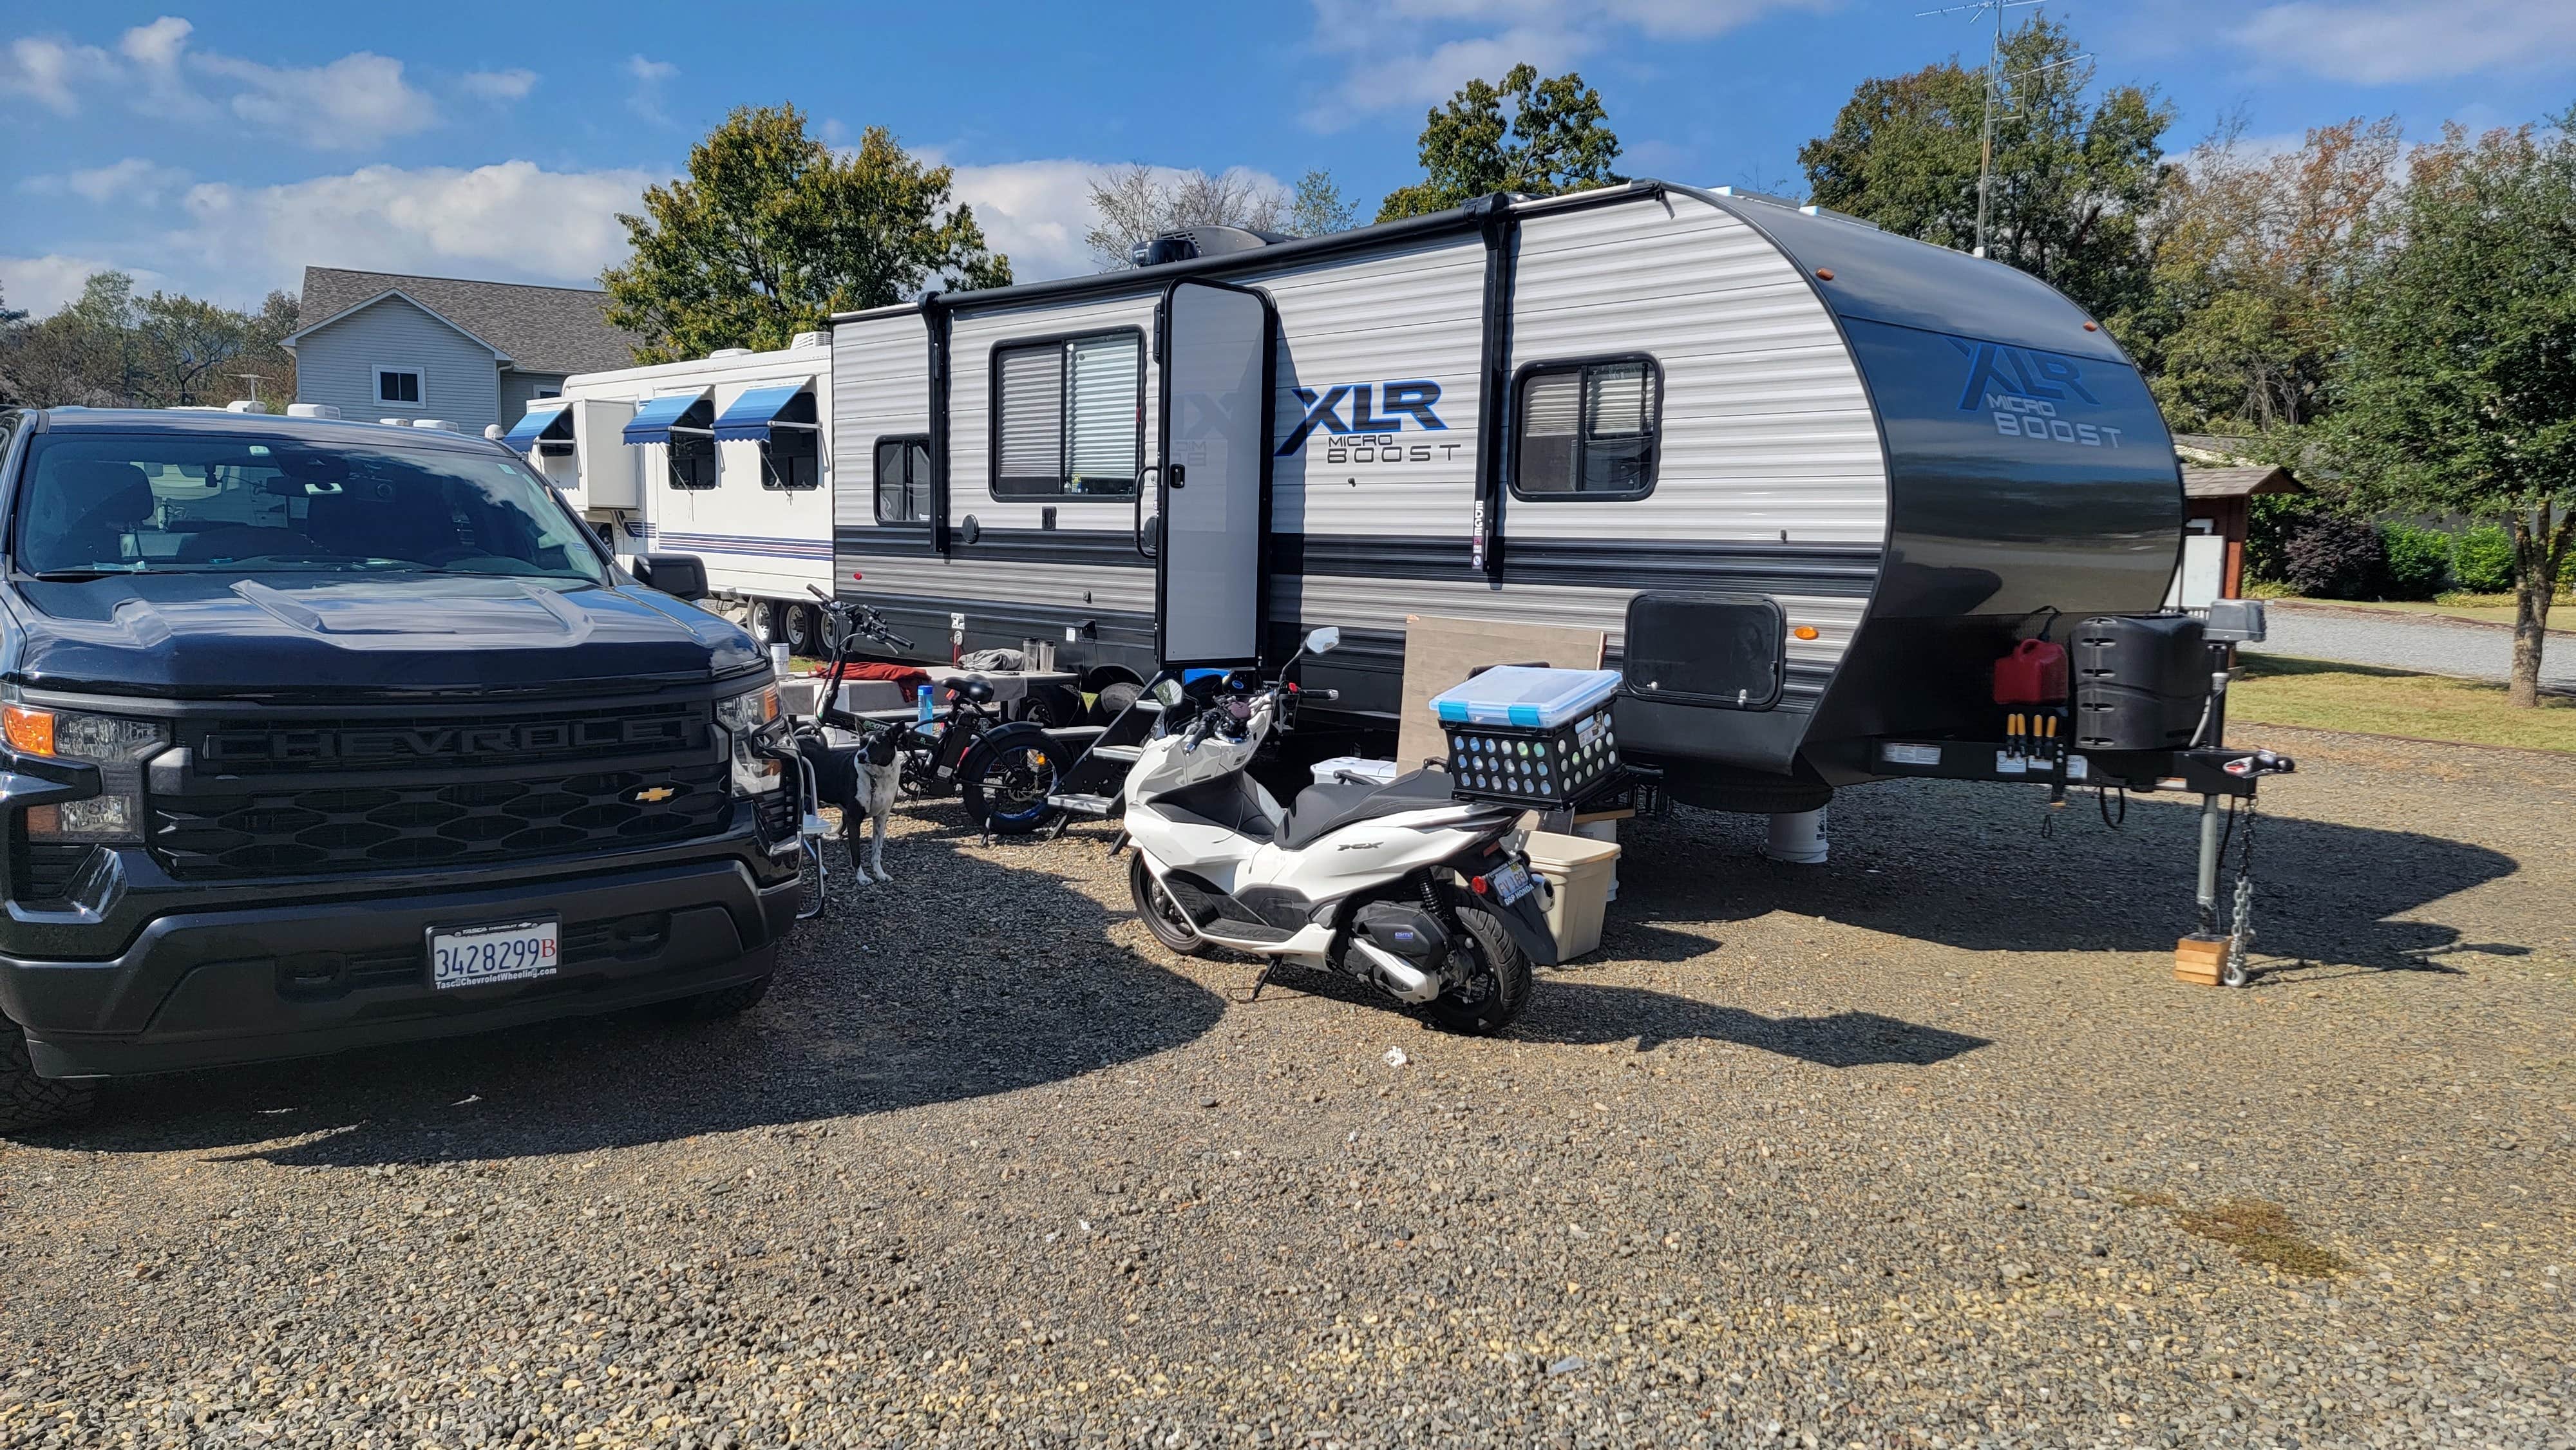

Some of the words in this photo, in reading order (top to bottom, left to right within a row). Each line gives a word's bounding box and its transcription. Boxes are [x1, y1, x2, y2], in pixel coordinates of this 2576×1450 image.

[1942, 335, 2101, 412] XLR
[1273, 379, 1449, 457] XLR
[1985, 393, 2056, 417] MICRO
[1328, 434, 1394, 448] MICRO
[1994, 411, 2121, 449] BOOST
[1327, 444, 1461, 464] BOOST
[1474, 500, 1484, 536] EDGE
[203, 712, 702, 760] CHEVROLET
[1504, 894, 1515, 907] DSP
[1515, 883, 1535, 899] HONDA
[436, 968, 556, 990] TascaChevroletWheeling.com
